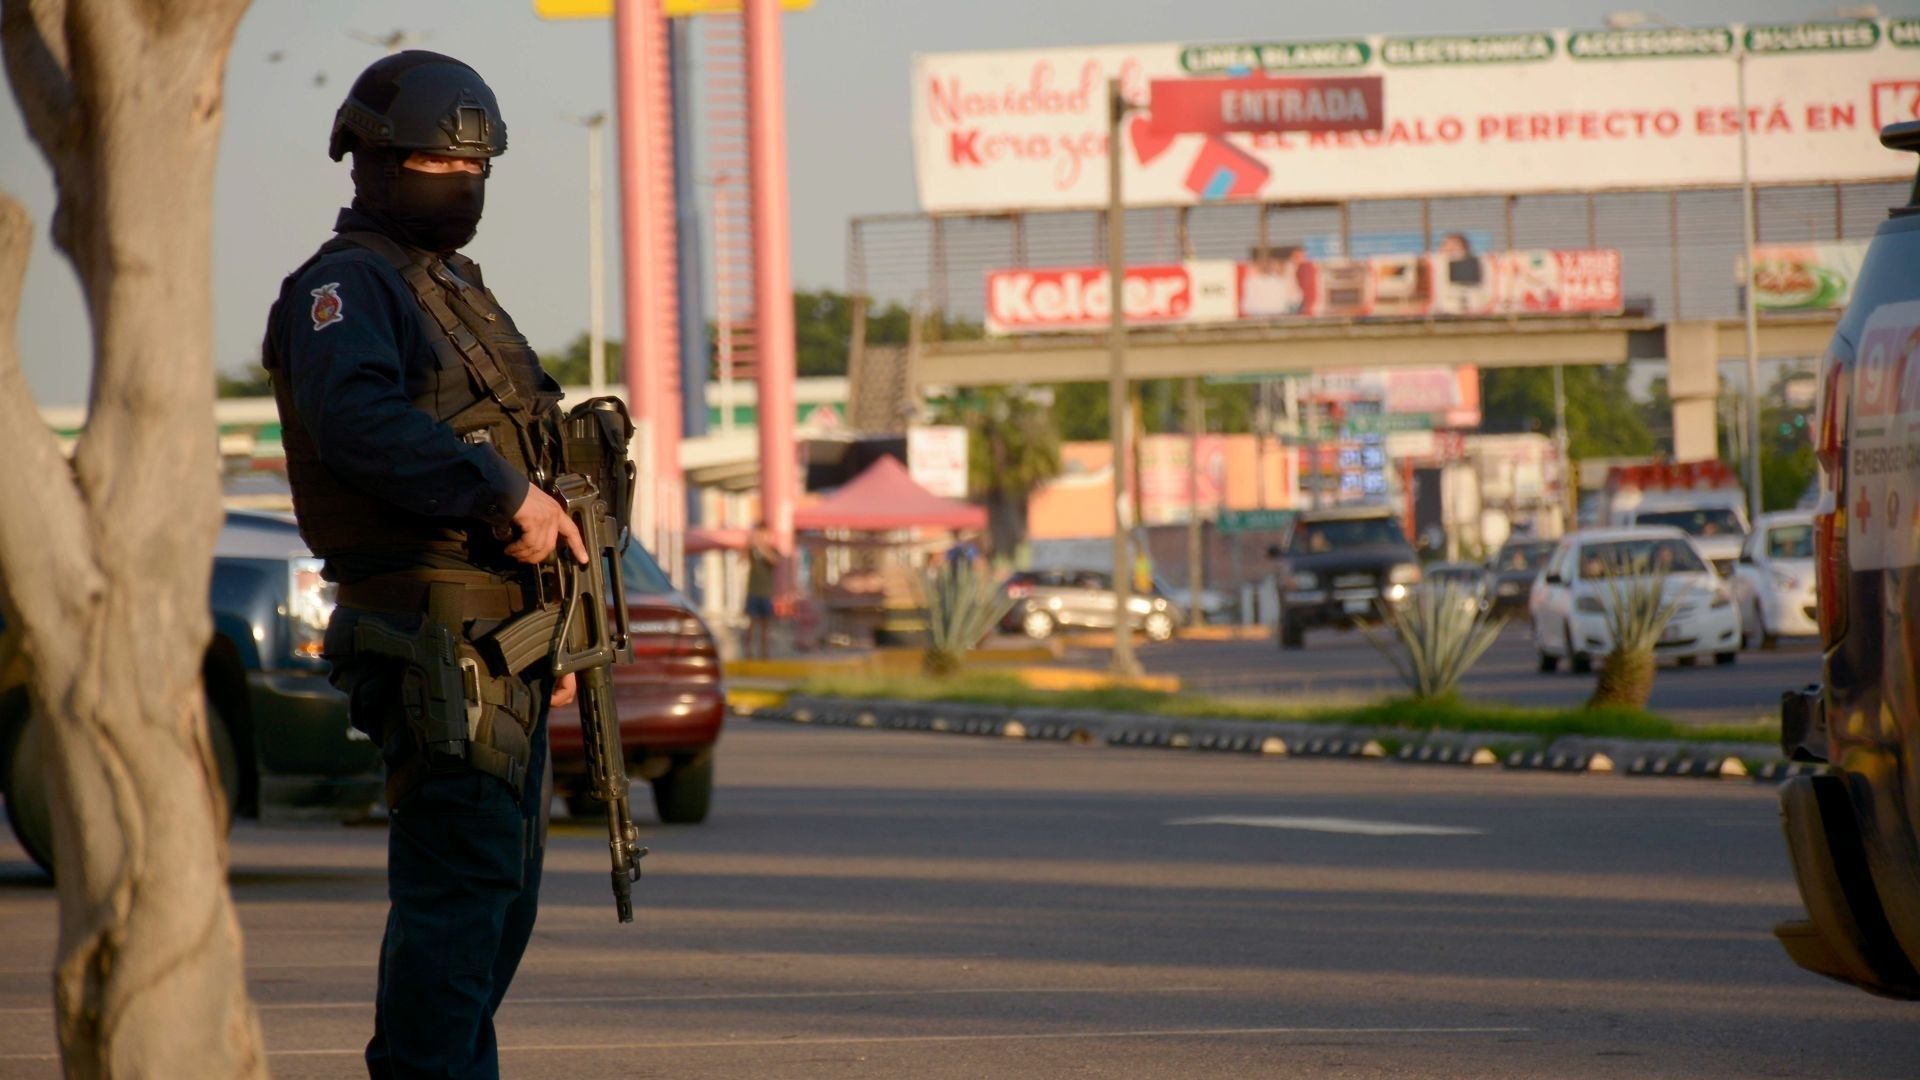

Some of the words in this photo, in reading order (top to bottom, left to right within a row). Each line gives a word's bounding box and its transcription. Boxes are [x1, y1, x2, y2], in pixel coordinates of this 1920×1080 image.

[1574, 29, 1729, 55] ACCESORIOS
[1752, 22, 1872, 50] JUGUETES
[1261, 42, 1361, 66] BLANCA
[928, 59, 1098, 126] Navidad
[1220, 88, 1367, 123] ENTRADA
[1477, 107, 1680, 142] PERFECTO
[1694, 101, 1793, 135] ESTÁ
[1806, 103, 1855, 132] EN
[946, 129, 1112, 192] Korazo
